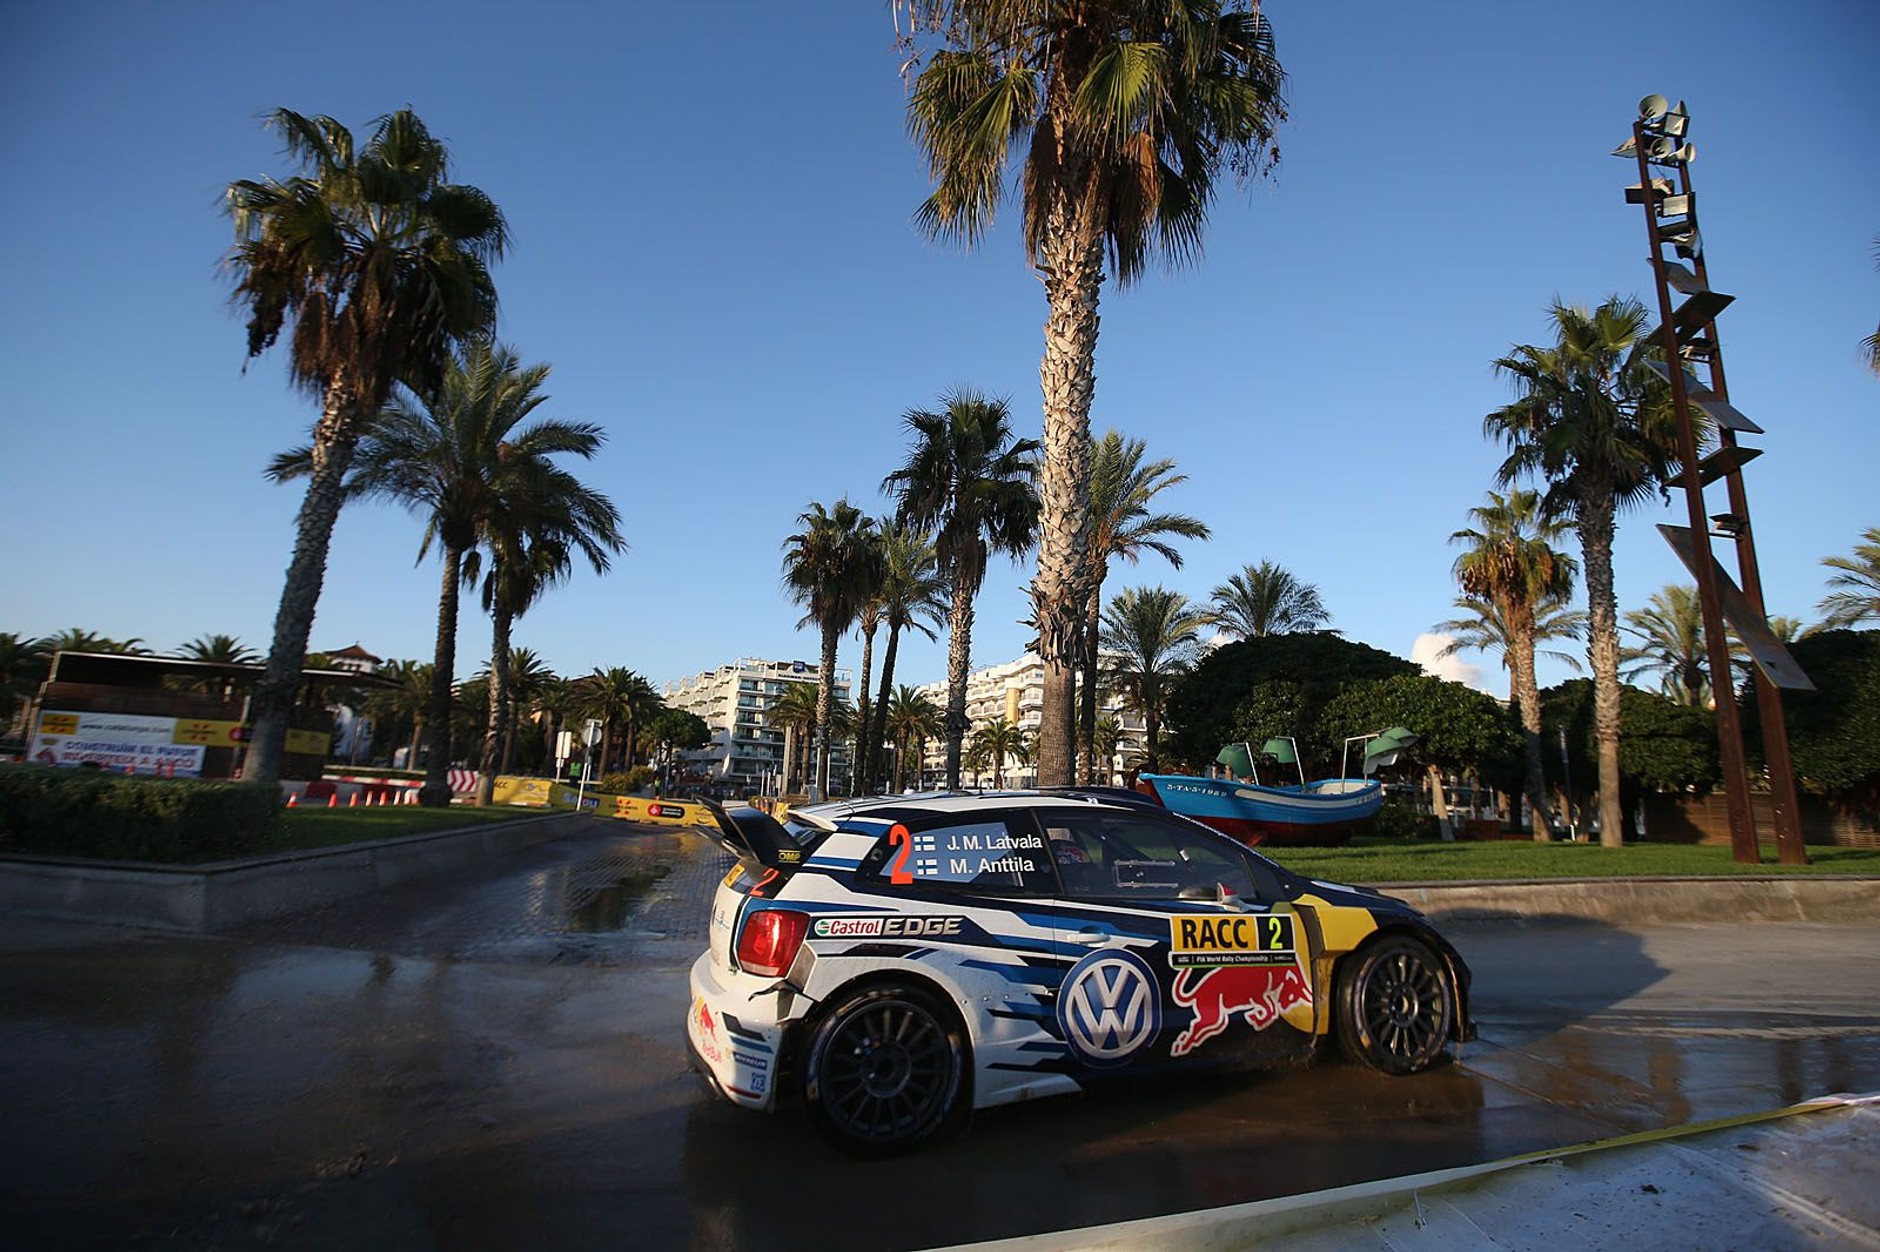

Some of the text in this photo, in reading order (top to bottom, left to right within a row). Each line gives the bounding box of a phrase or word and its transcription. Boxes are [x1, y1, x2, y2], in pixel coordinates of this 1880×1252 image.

[563, 792, 600, 808] Saou
[947, 833, 1043, 850] J. M. Latvala
[778, 852, 801, 861] OMP
[889, 824, 913, 884] 2
[950, 857, 1035, 874] M. Anttila
[749, 868, 780, 897] 2
[830, 918, 964, 936] Castrol EDGE
[1181, 917, 1283, 949] RACC 2
